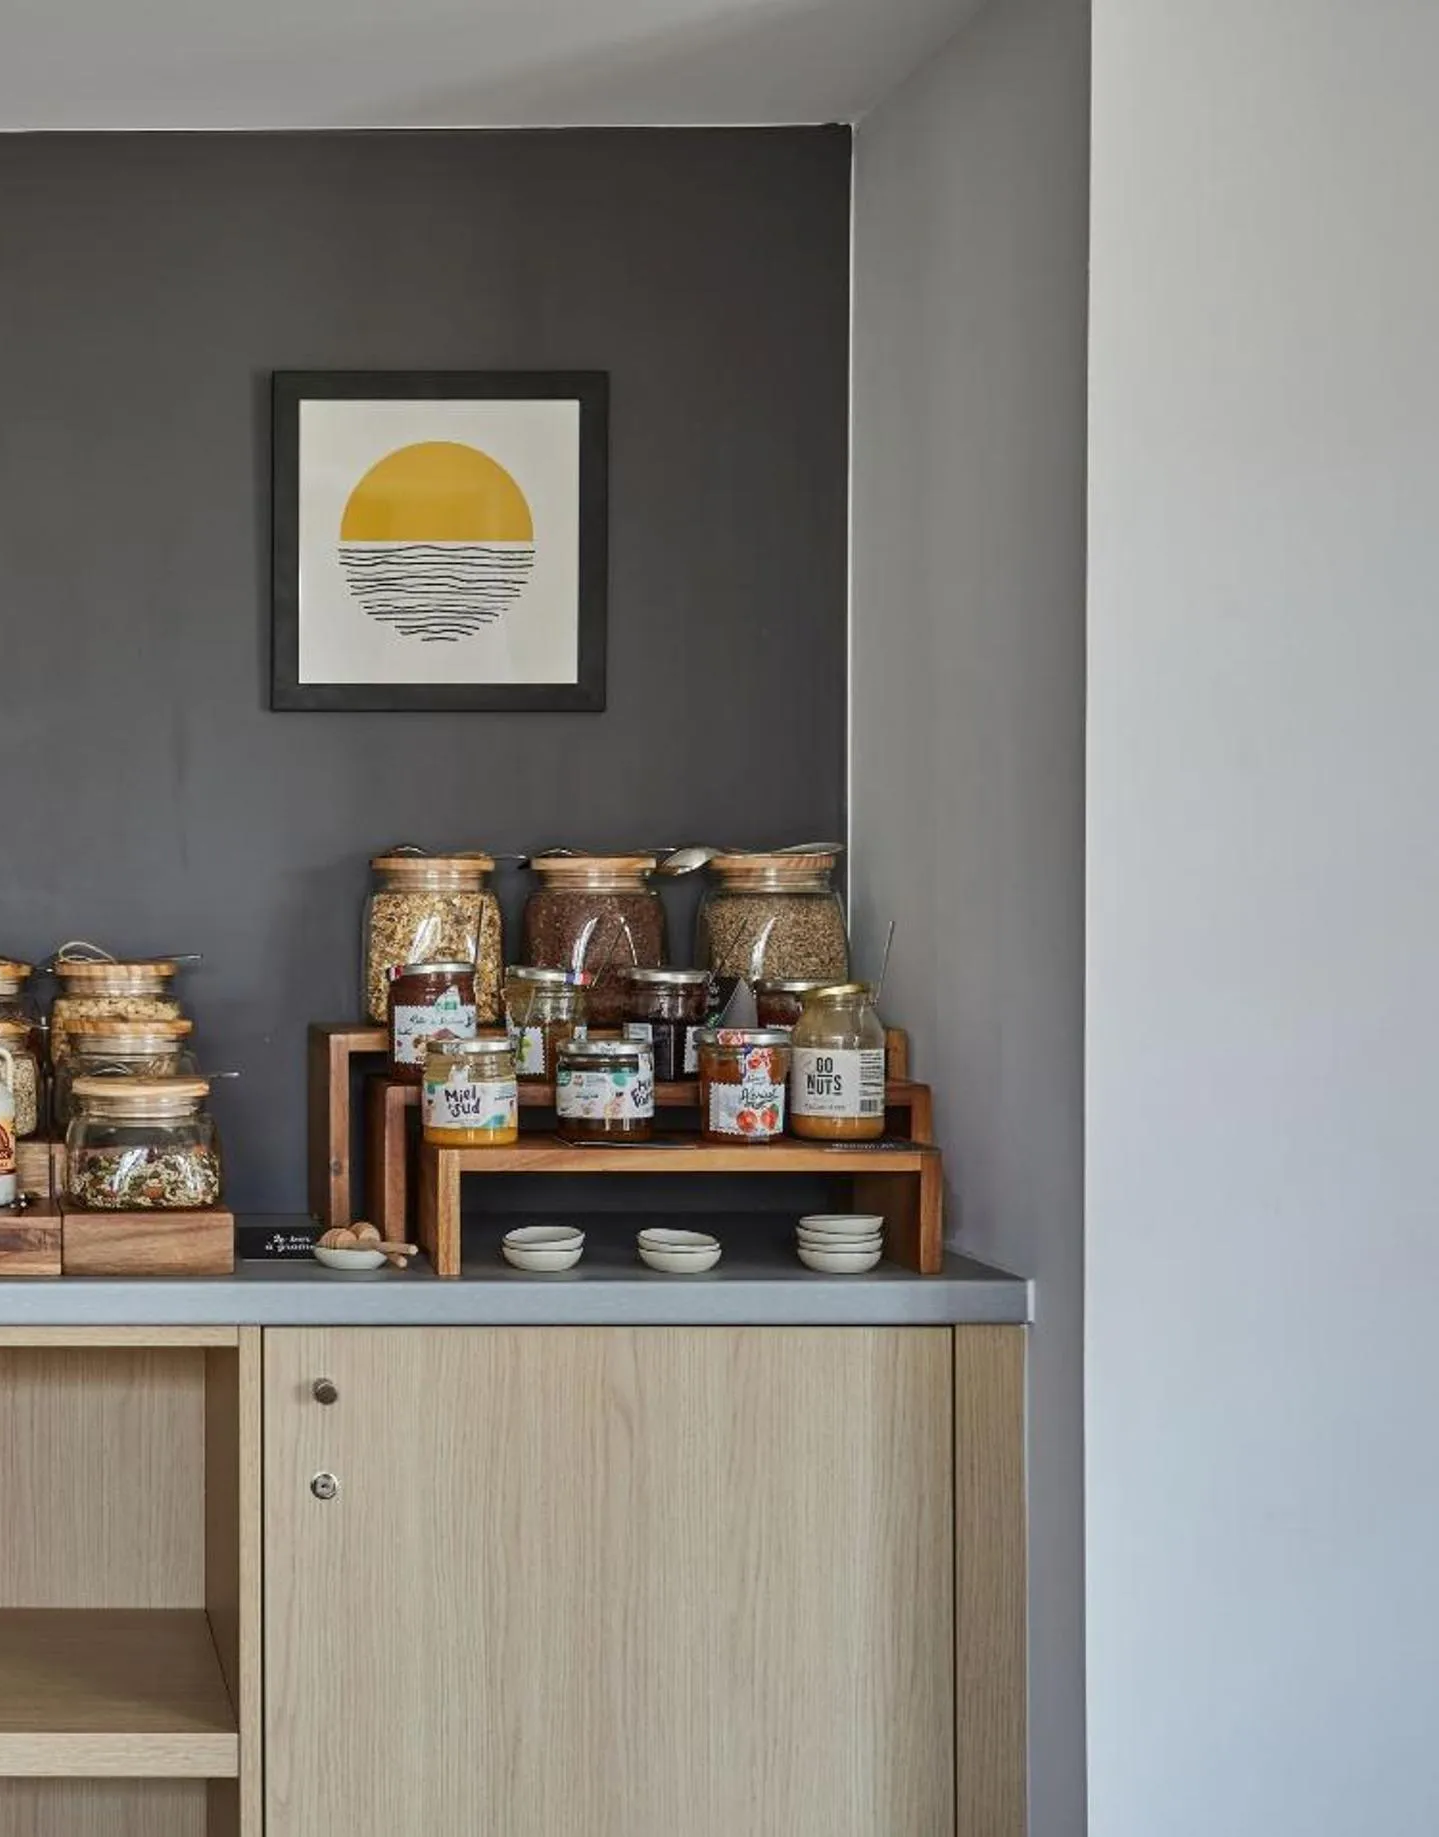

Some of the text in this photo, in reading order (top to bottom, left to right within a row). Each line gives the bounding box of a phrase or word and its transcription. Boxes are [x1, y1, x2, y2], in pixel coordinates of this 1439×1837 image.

[816, 1057, 833, 1073] GO
[807, 1074, 842, 1095] NUTS
[444, 1085, 476, 1102] Miel
